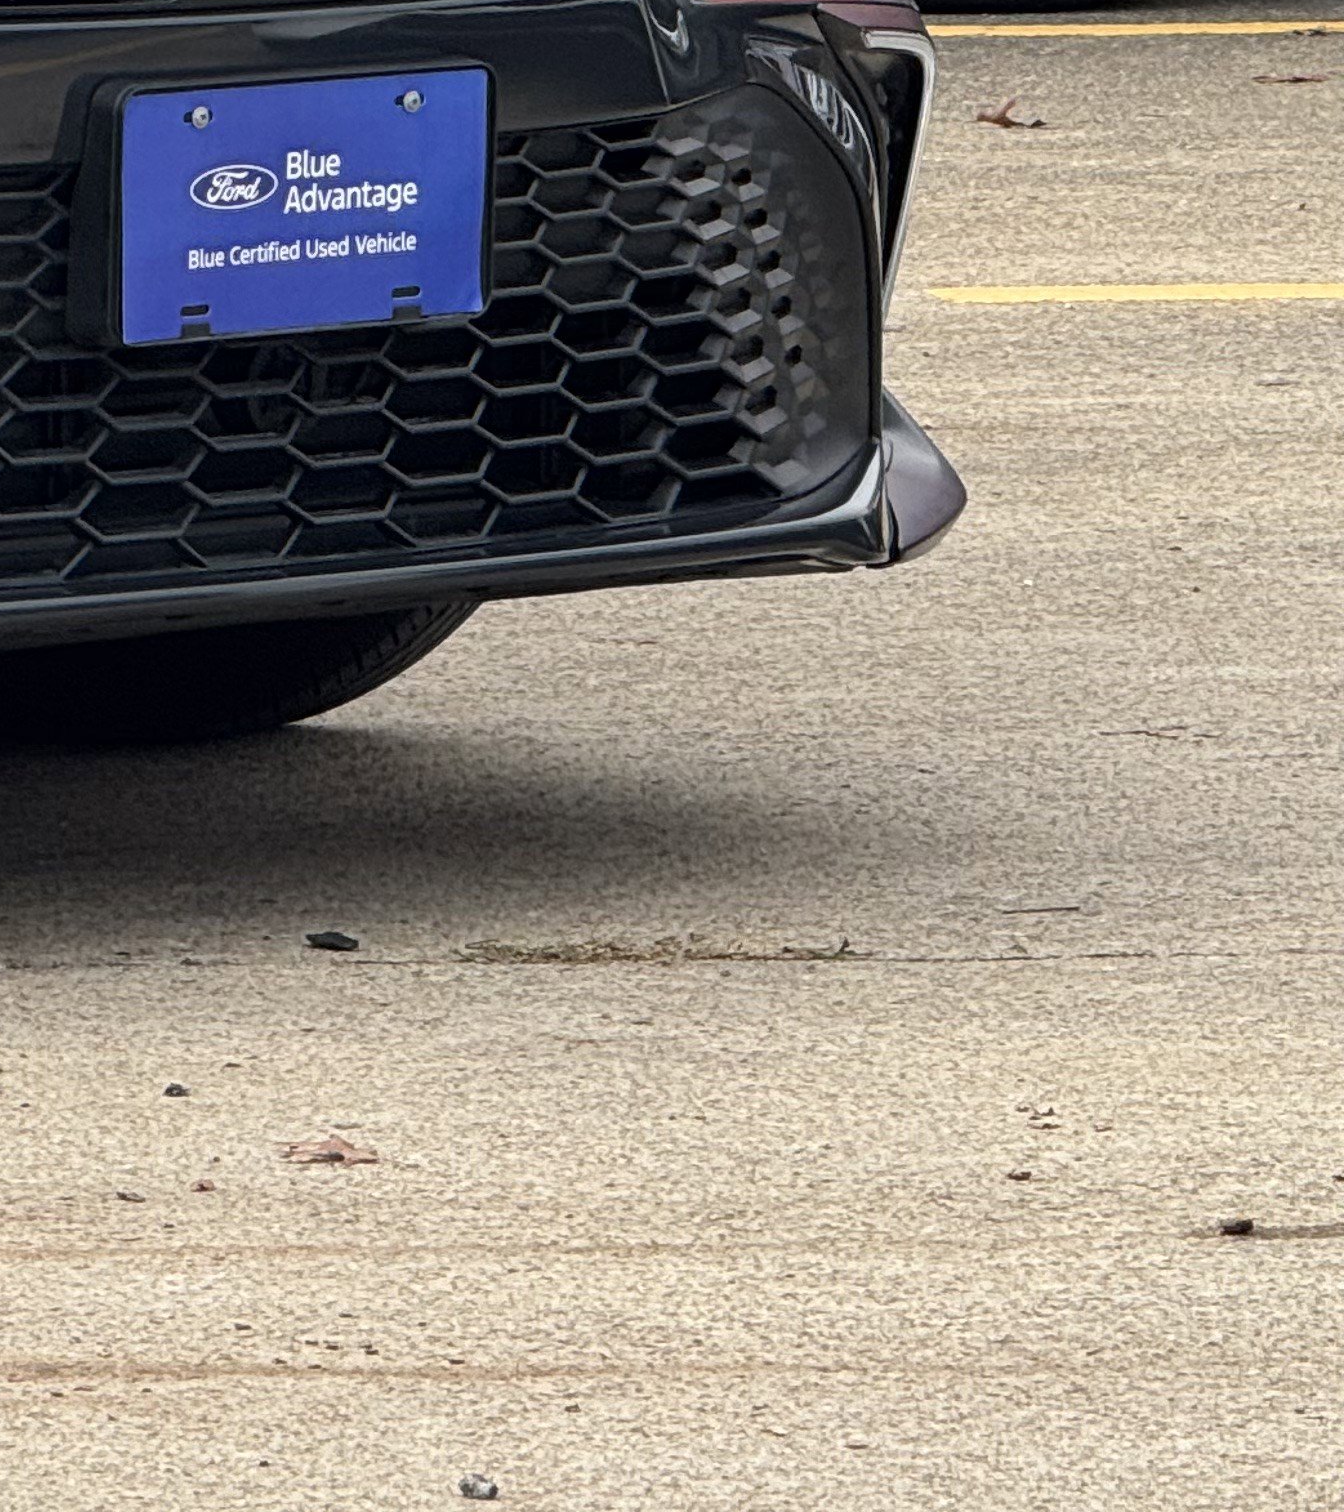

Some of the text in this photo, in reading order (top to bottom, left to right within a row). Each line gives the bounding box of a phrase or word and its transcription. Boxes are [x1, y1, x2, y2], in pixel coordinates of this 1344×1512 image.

[286, 149, 341, 180] Blue
[282, 181, 418, 214] Advantage
[188, 231, 417, 270] Blue Certified Used Vehicle
